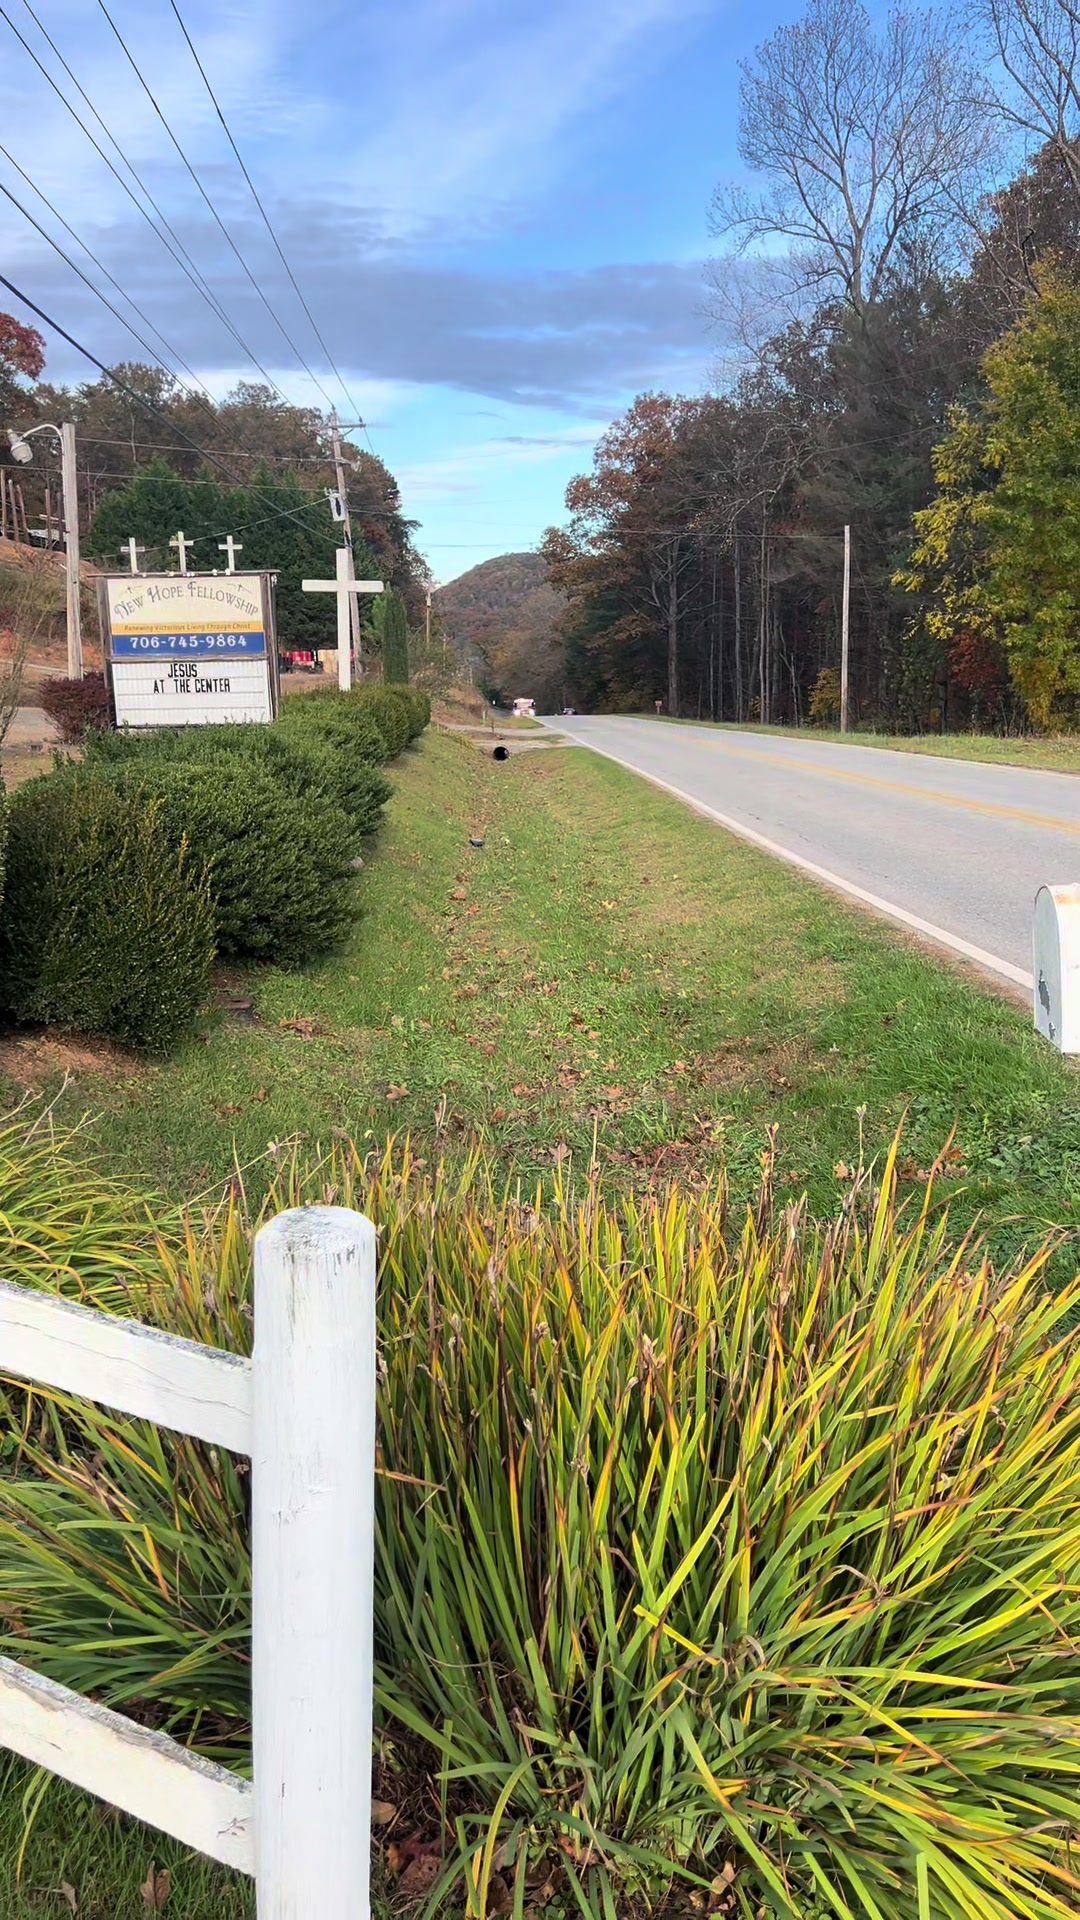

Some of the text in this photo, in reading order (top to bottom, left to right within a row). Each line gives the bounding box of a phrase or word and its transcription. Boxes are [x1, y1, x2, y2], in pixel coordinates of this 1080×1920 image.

[114, 581, 259, 619] NEW HOPE FELLOWSHIP
[187, 624, 205, 632] Living
[130, 634, 247, 649] 706-745-9864
[168, 663, 198, 678] JESUS
[153, 678, 231, 694] AT THE CENTER
